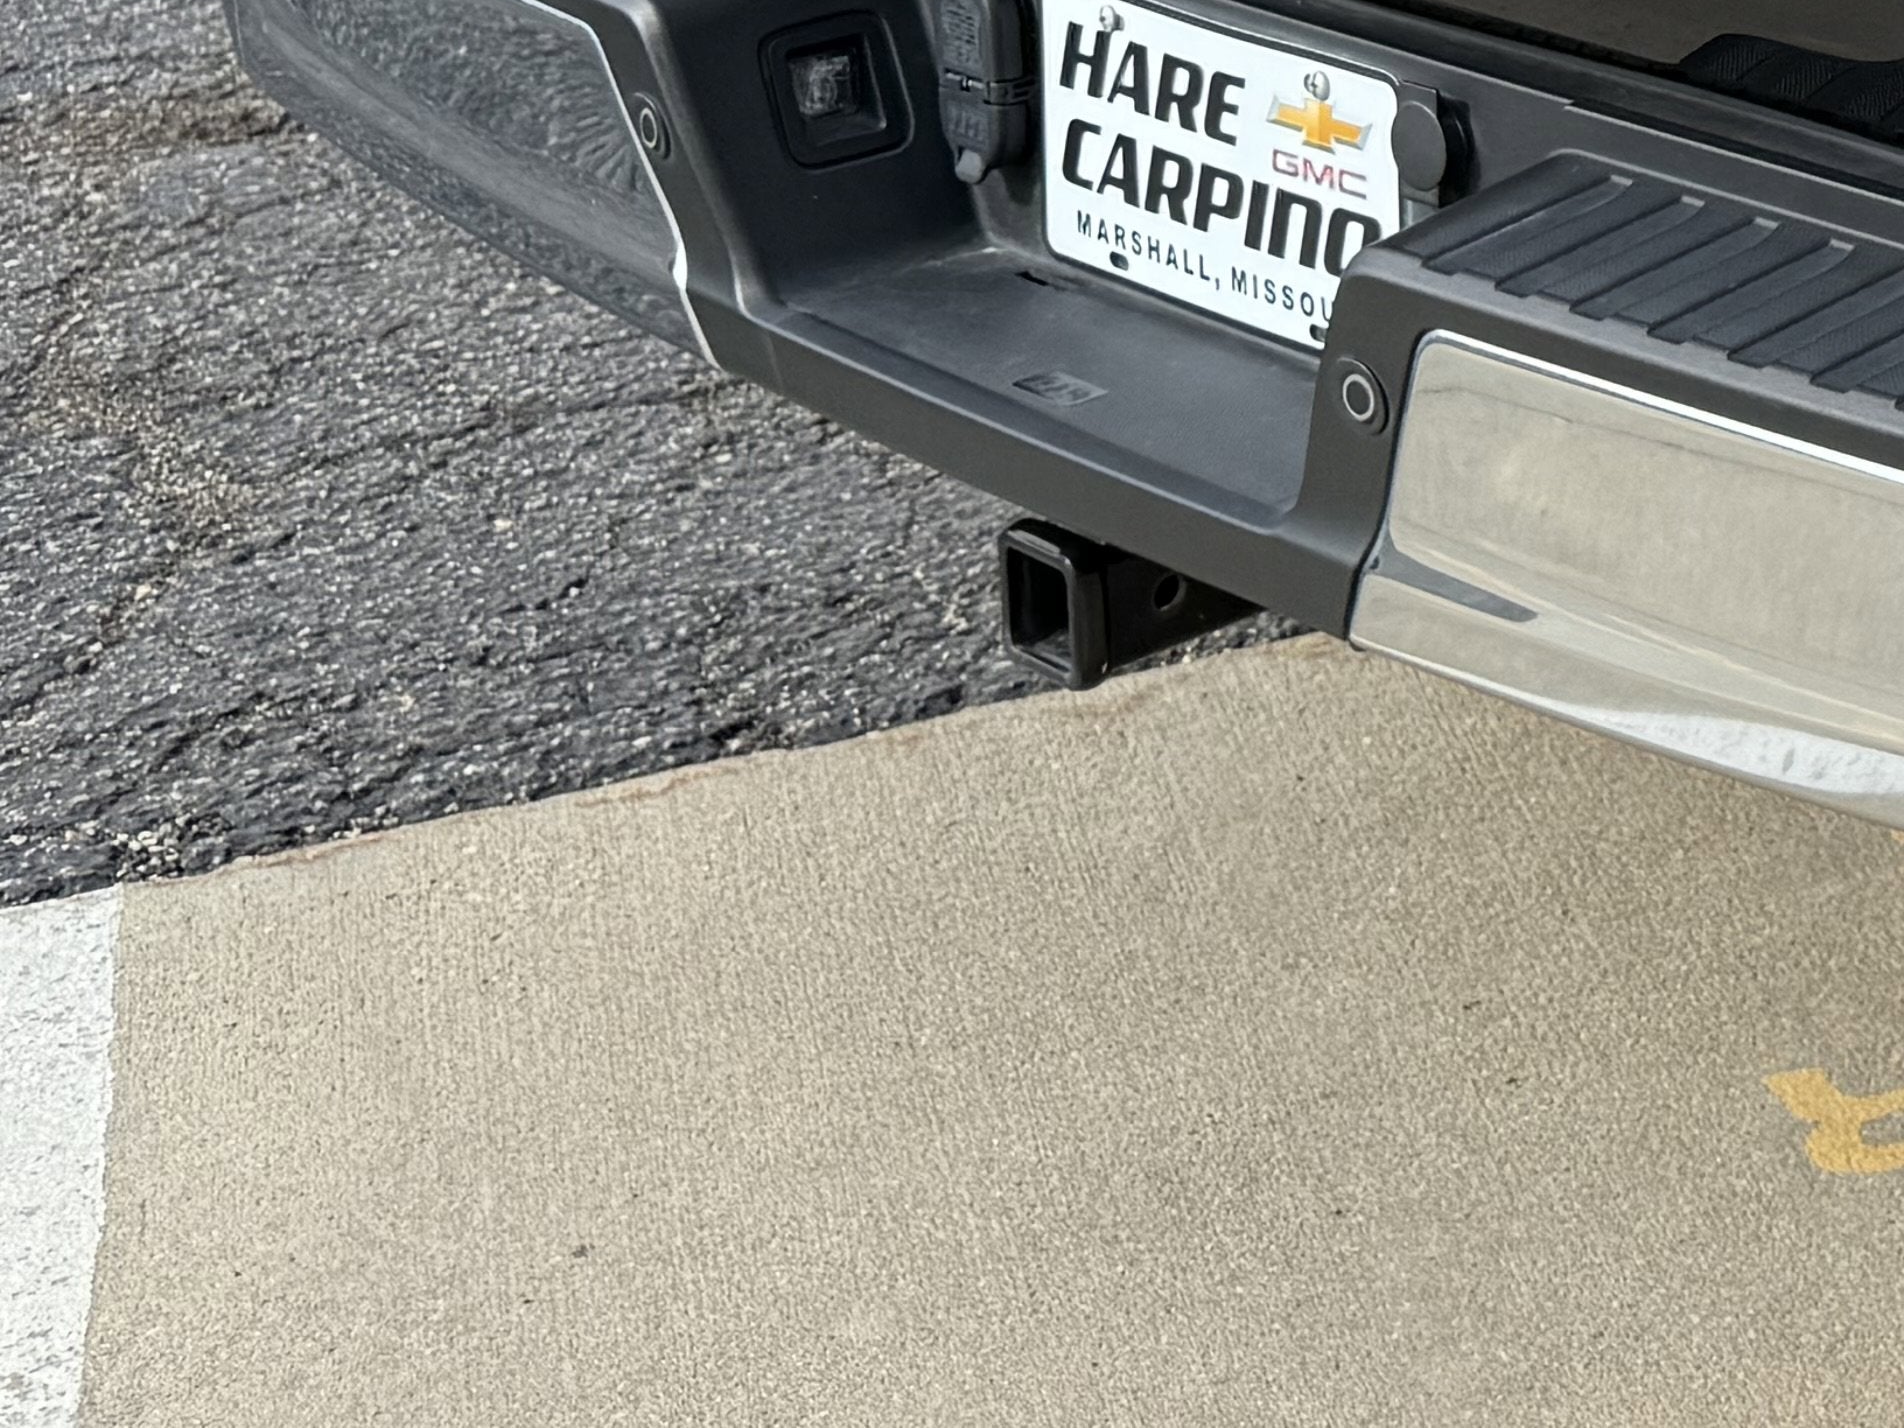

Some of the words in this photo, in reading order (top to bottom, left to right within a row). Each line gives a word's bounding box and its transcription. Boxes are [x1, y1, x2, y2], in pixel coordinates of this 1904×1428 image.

[1058, 20, 1246, 147] HARE
[1061, 117, 1383, 278] CARPINO
[1271, 148, 1369, 200] GMC
[1076, 209, 1221, 290] MARSHALL,
